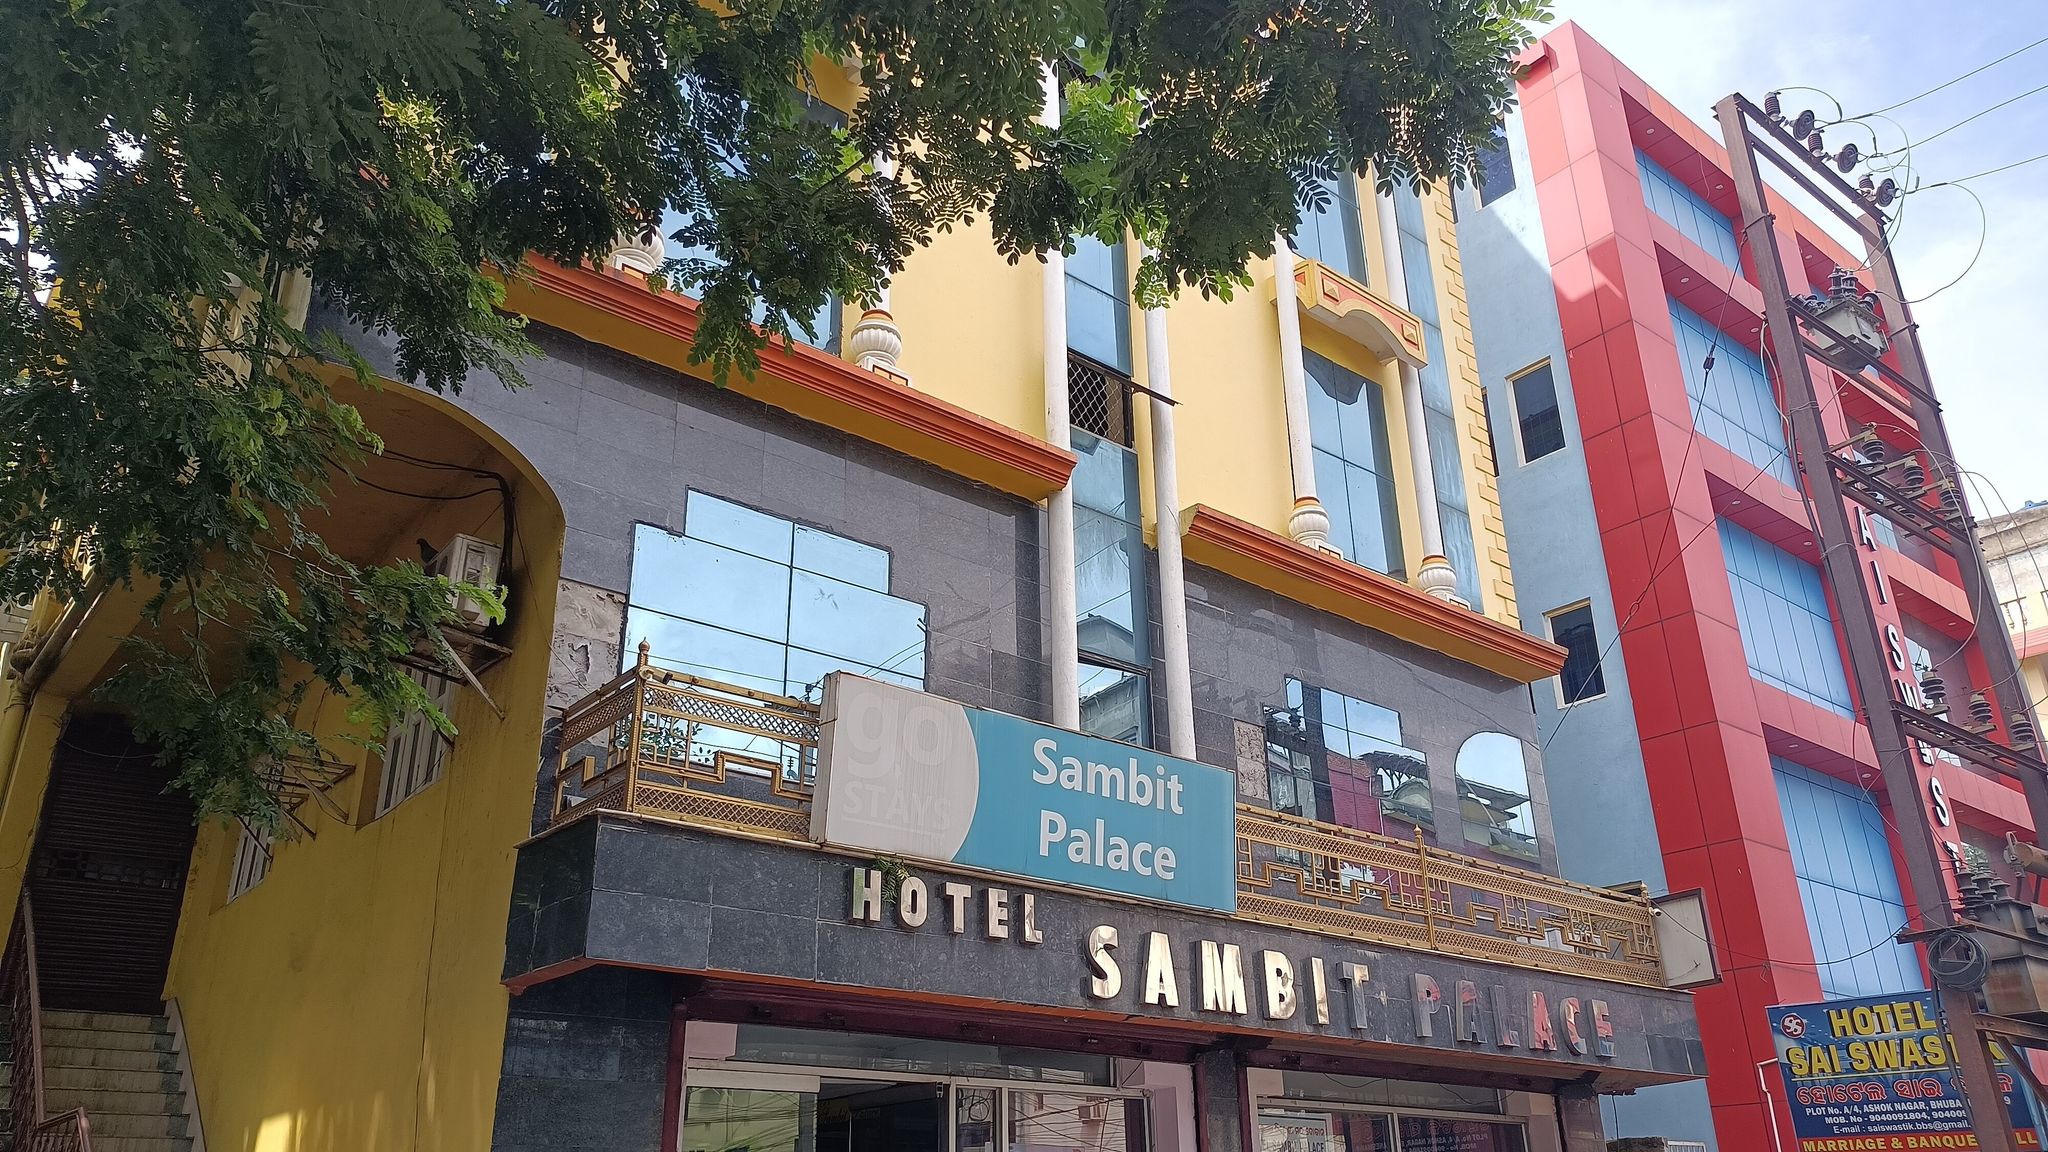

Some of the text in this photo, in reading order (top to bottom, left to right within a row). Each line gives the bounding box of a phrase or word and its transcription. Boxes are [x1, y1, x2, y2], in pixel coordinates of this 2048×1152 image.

[846, 692, 953, 779] go
[1032, 738, 1184, 815] Sambit
[842, 781, 950, 833] STAYS
[1039, 809, 1177, 880] Palace
[850, 867, 1616, 1058] HOTEL SAMBIT PALACE
[1828, 1000, 1937, 1037] HOTEL
[1788, 1044, 1841, 1076] SAI
[1806, 1107, 1826, 1116] PLOT
[1828, 1106, 1842, 1115] No.
[1843, 1105, 1862, 1115] A/4,
[1864, 1102, 1893, 1113] ASHOK
[1894, 1101, 1929, 1111] NAGAR,
[1825, 1116, 1849, 1124] MOB.
[1869, 1111, 1931, 1122] 9040091804,
[1803, 1138, 1887, 1152] MARRIAGE
[1891, 1137, 1903, 1149] &
[1906, 1134, 1979, 1148] BANQUE
[1833, 1125, 1861, 1133] E-mail
